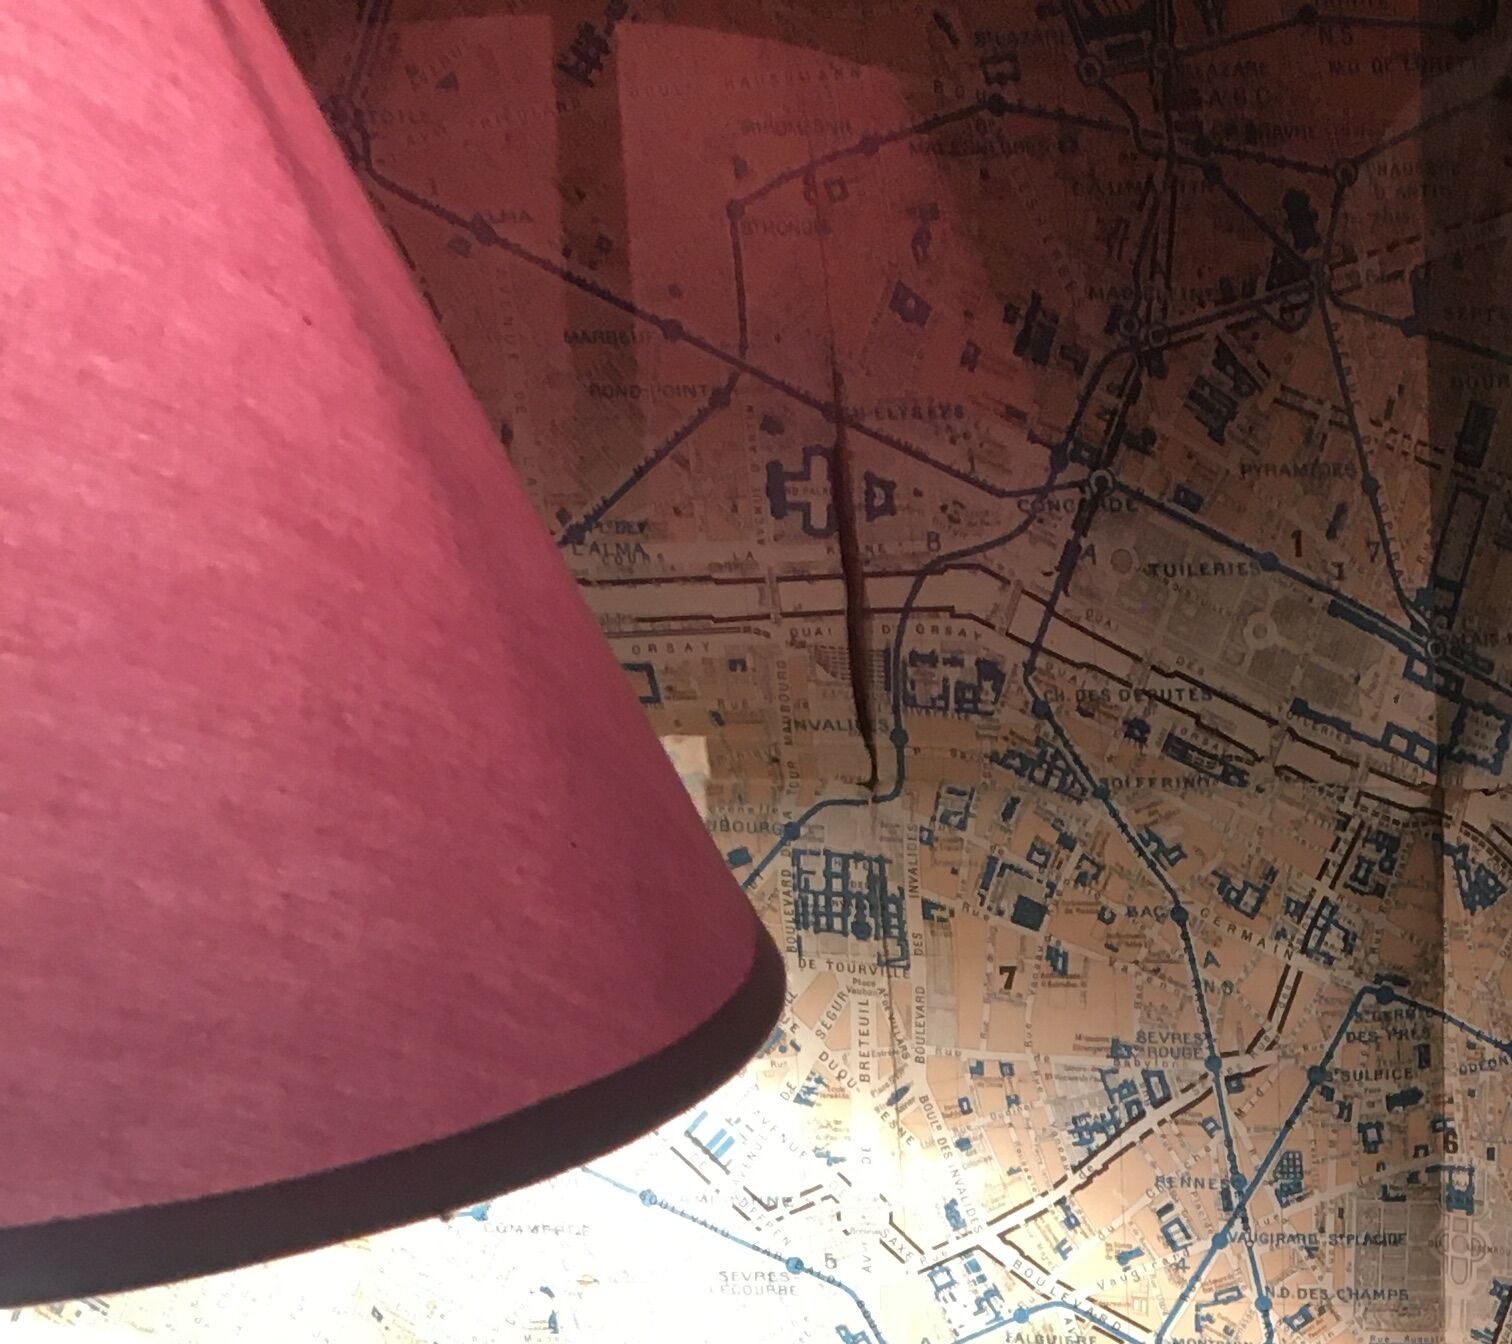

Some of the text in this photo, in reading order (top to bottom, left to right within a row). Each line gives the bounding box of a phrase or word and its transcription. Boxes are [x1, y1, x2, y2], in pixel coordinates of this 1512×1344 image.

[907, 824, 926, 1065] BOULEVARD DES INVALIDES
[999, 966, 1018, 990] 7
[859, 999, 871, 1083] BRETEUIL
[1336, 1288, 1408, 1299] CHAMPS
